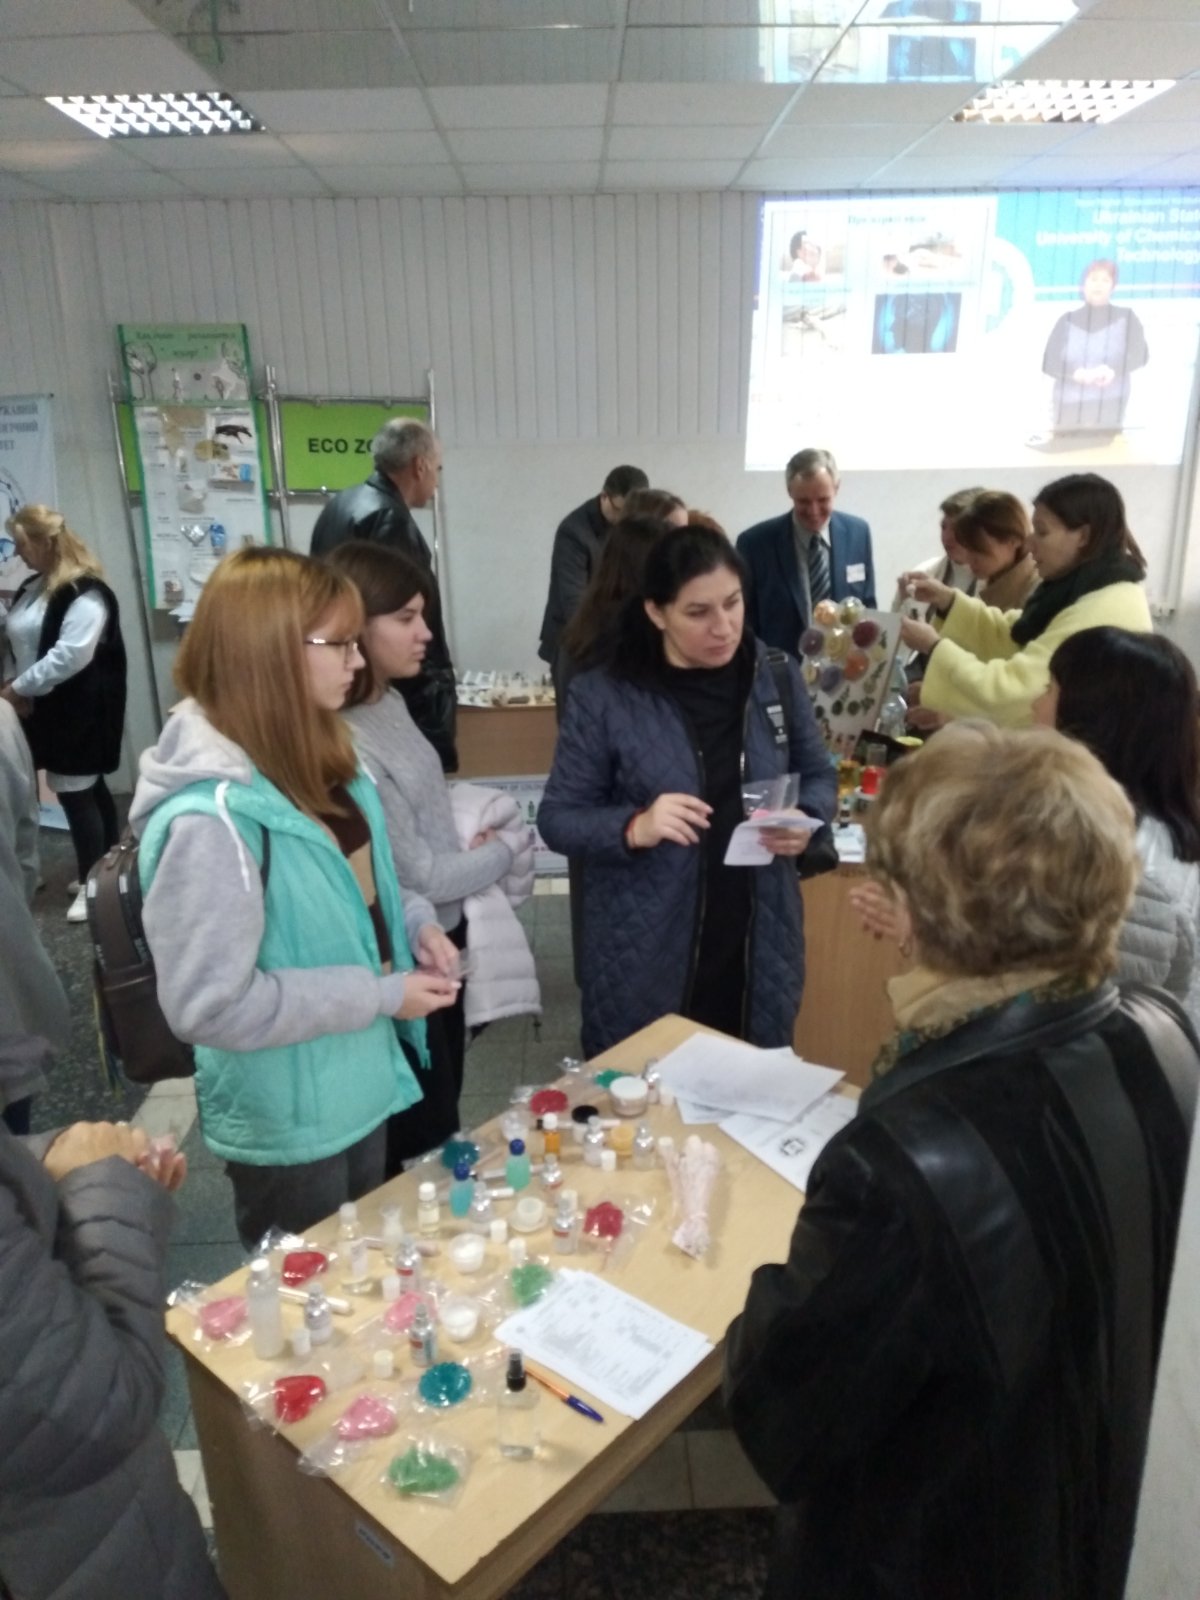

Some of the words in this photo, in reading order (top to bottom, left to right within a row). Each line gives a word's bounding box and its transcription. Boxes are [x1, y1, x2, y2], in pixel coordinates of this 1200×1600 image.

[1092, 208, 1165, 224] Ukrainian
[1036, 230, 1112, 247] University
[1115, 228, 1133, 244] of
[308, 438, 348, 454] ECO
